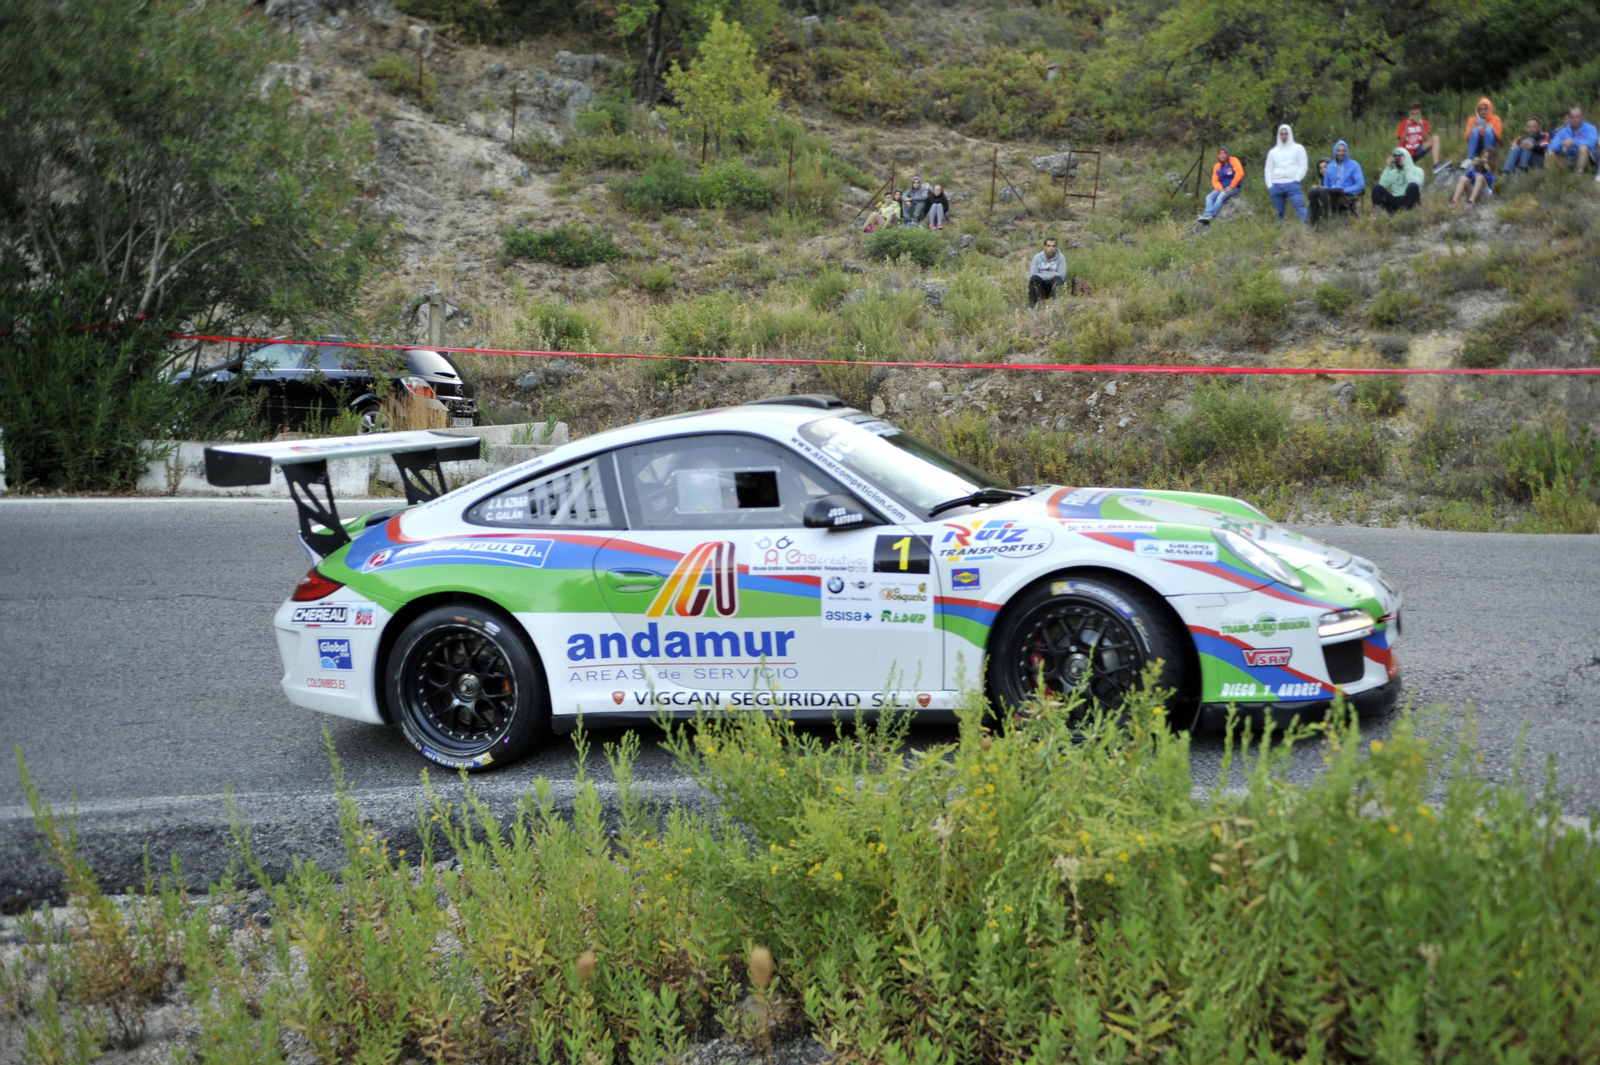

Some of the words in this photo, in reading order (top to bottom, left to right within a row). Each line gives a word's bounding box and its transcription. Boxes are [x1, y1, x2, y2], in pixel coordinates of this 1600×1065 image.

[791, 437, 907, 521] www.aznarcompeticion.com
[892, 537, 912, 570] 1
[939, 543, 1046, 557] TRANSPORTES
[294, 608, 347, 621] CHEREAU
[825, 611, 862, 621] asisa
[320, 641, 348, 652] Global
[567, 622, 795, 661] andamur
[569, 669, 645, 683] AREAS
[658, 668, 681, 680] de
[694, 668, 798, 680] SERVCIO
[1221, 683, 1257, 697] DIEGO
[1277, 682, 1322, 697] ANDRES
[633, 691, 720, 705] VIGCAN
[730, 691, 861, 707] SEGURIDAD
